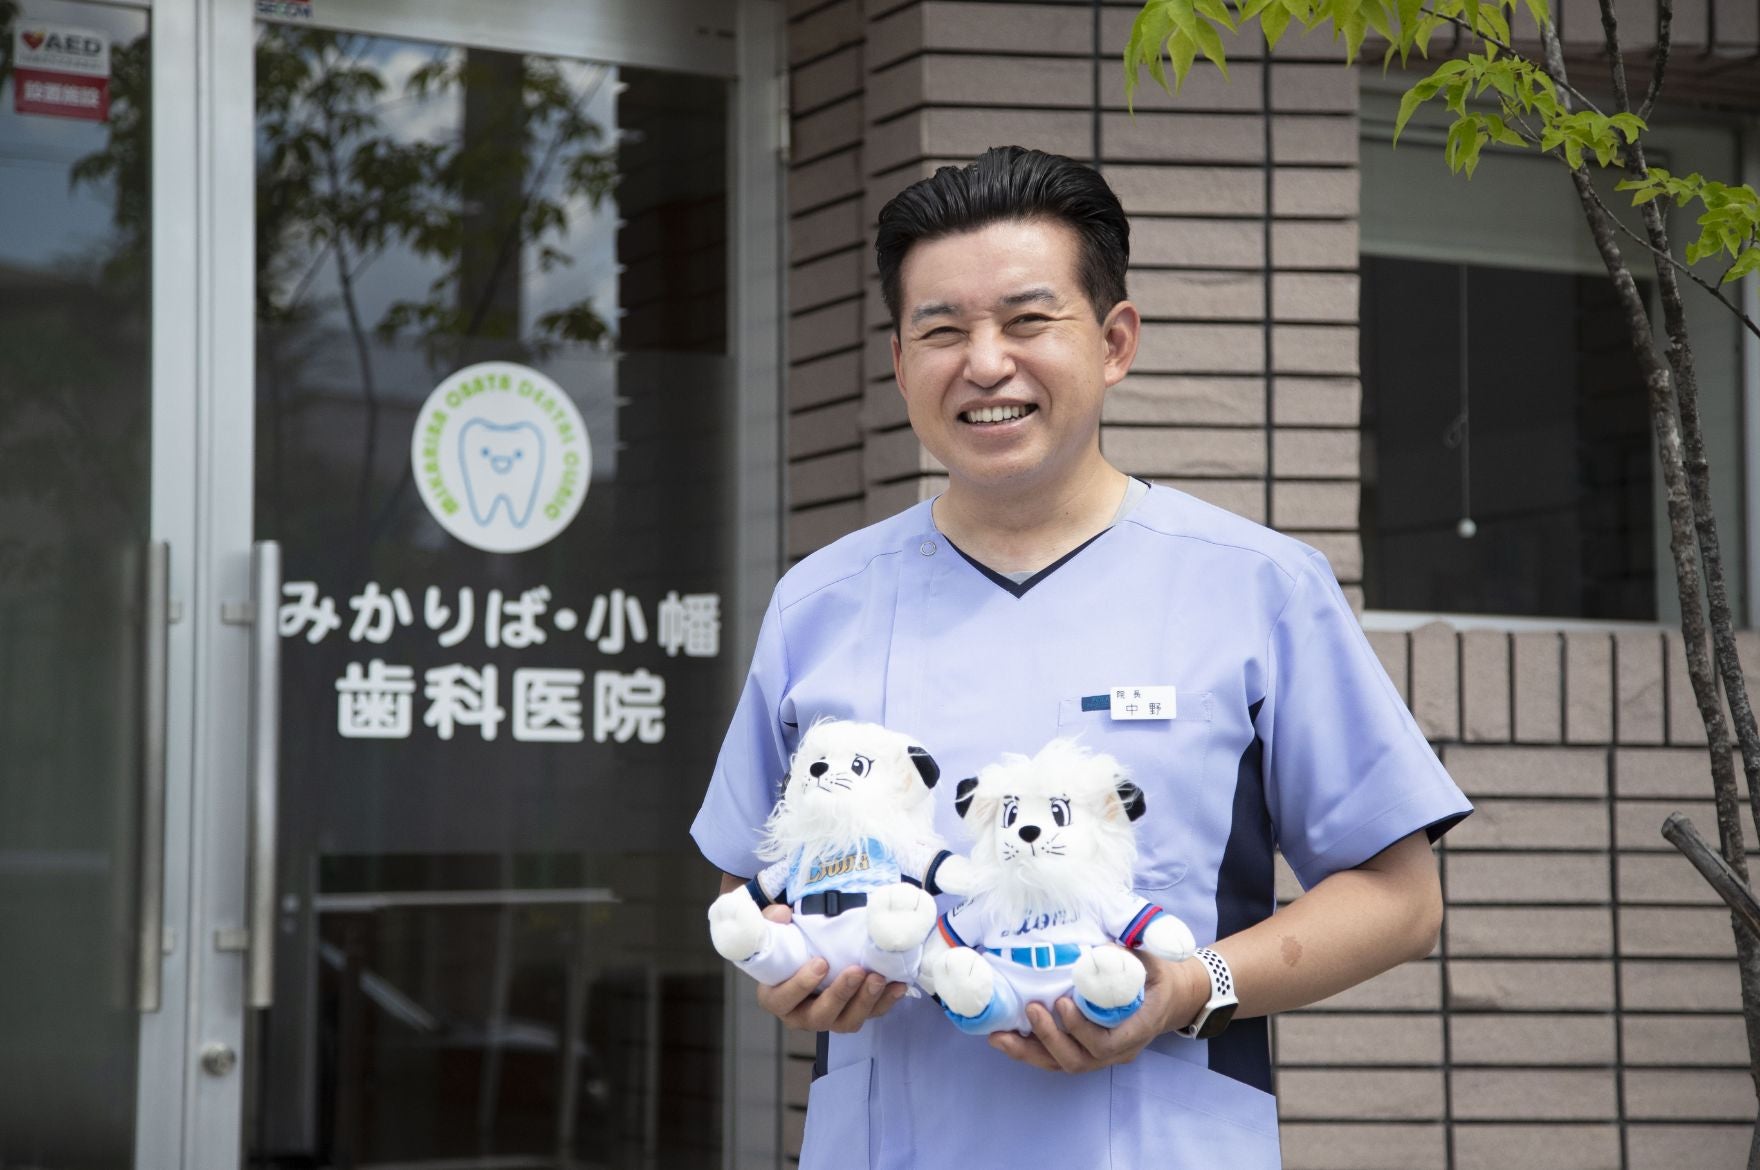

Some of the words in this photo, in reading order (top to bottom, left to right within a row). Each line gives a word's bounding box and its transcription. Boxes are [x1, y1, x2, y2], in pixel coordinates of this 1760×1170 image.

[45, 33, 101, 57] AED
[518, 380, 575, 444] DENTAL
[544, 451, 579, 520] CLINIC
[278, 581, 721, 658] みかりば・小幡
[335, 658, 666, 744] 歯科医院
[1125, 702, 1162, 716] 中野
